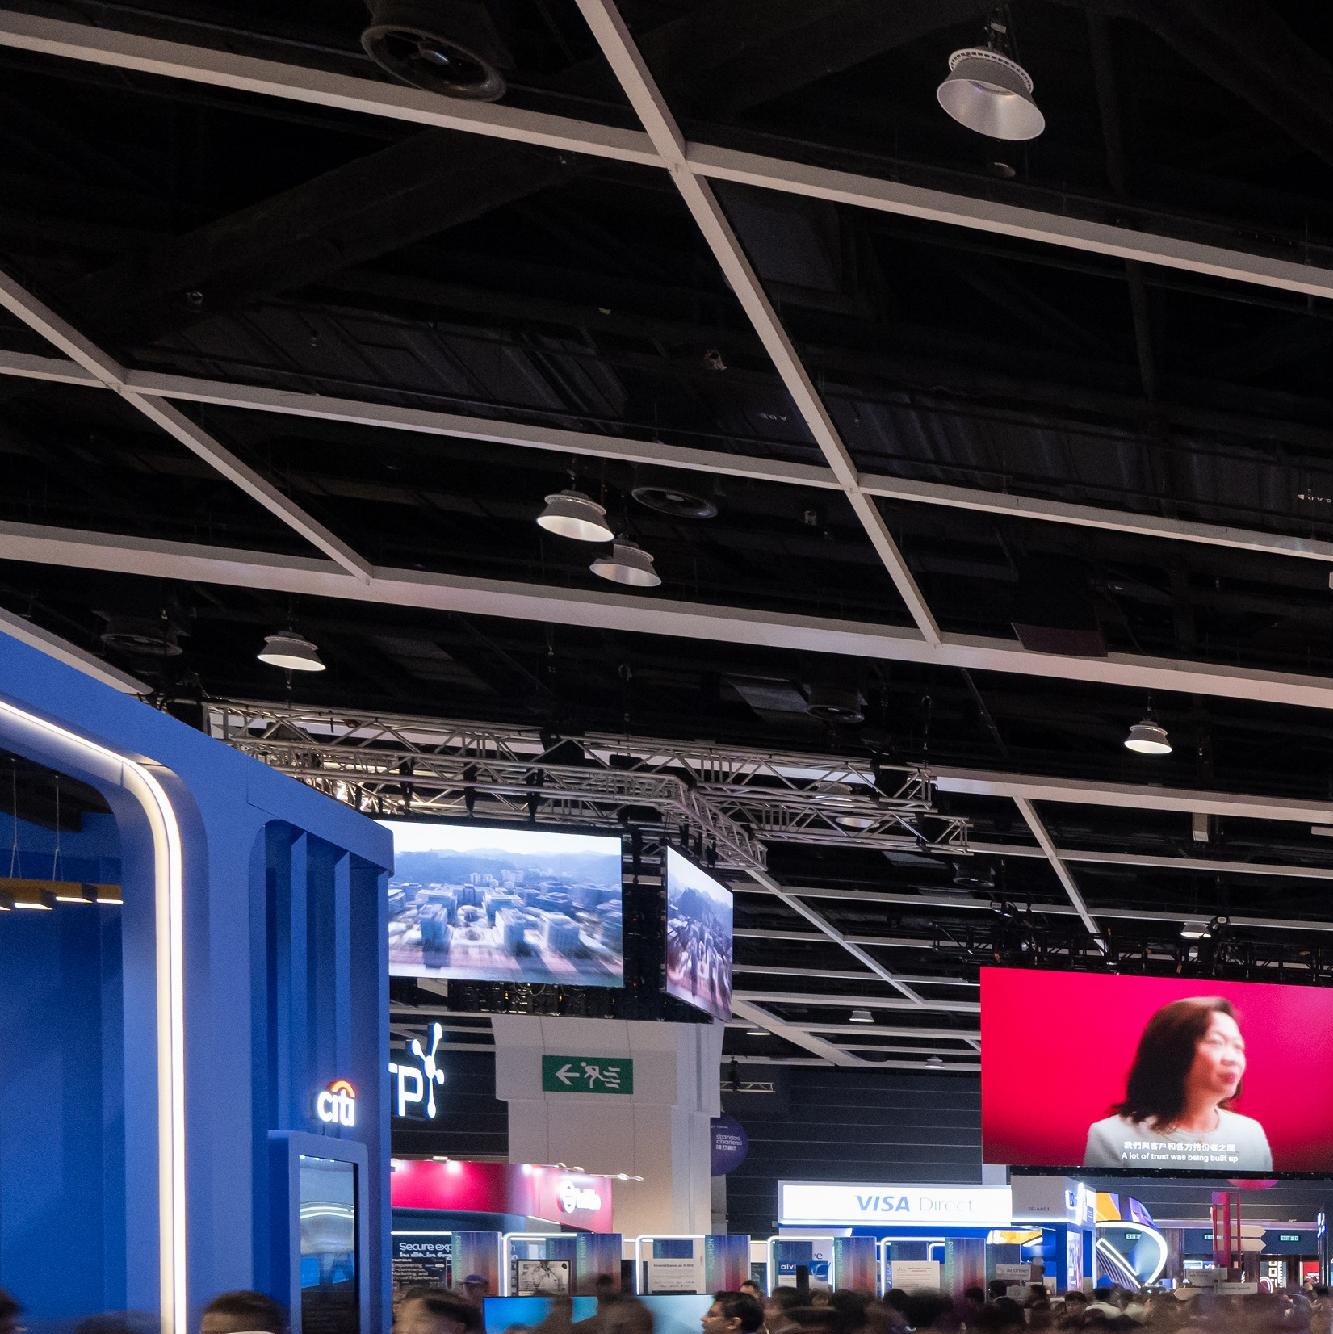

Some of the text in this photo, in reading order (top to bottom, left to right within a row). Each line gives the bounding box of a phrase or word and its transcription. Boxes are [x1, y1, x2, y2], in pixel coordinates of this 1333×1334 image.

[316, 1081, 356, 1127] citi
[1121, 1152, 1128, 1160] A
[1129, 1152, 1140, 1160] lot
[857, 1195, 975, 1212] VISA Direct
[399, 1242, 434, 1251] Secure
